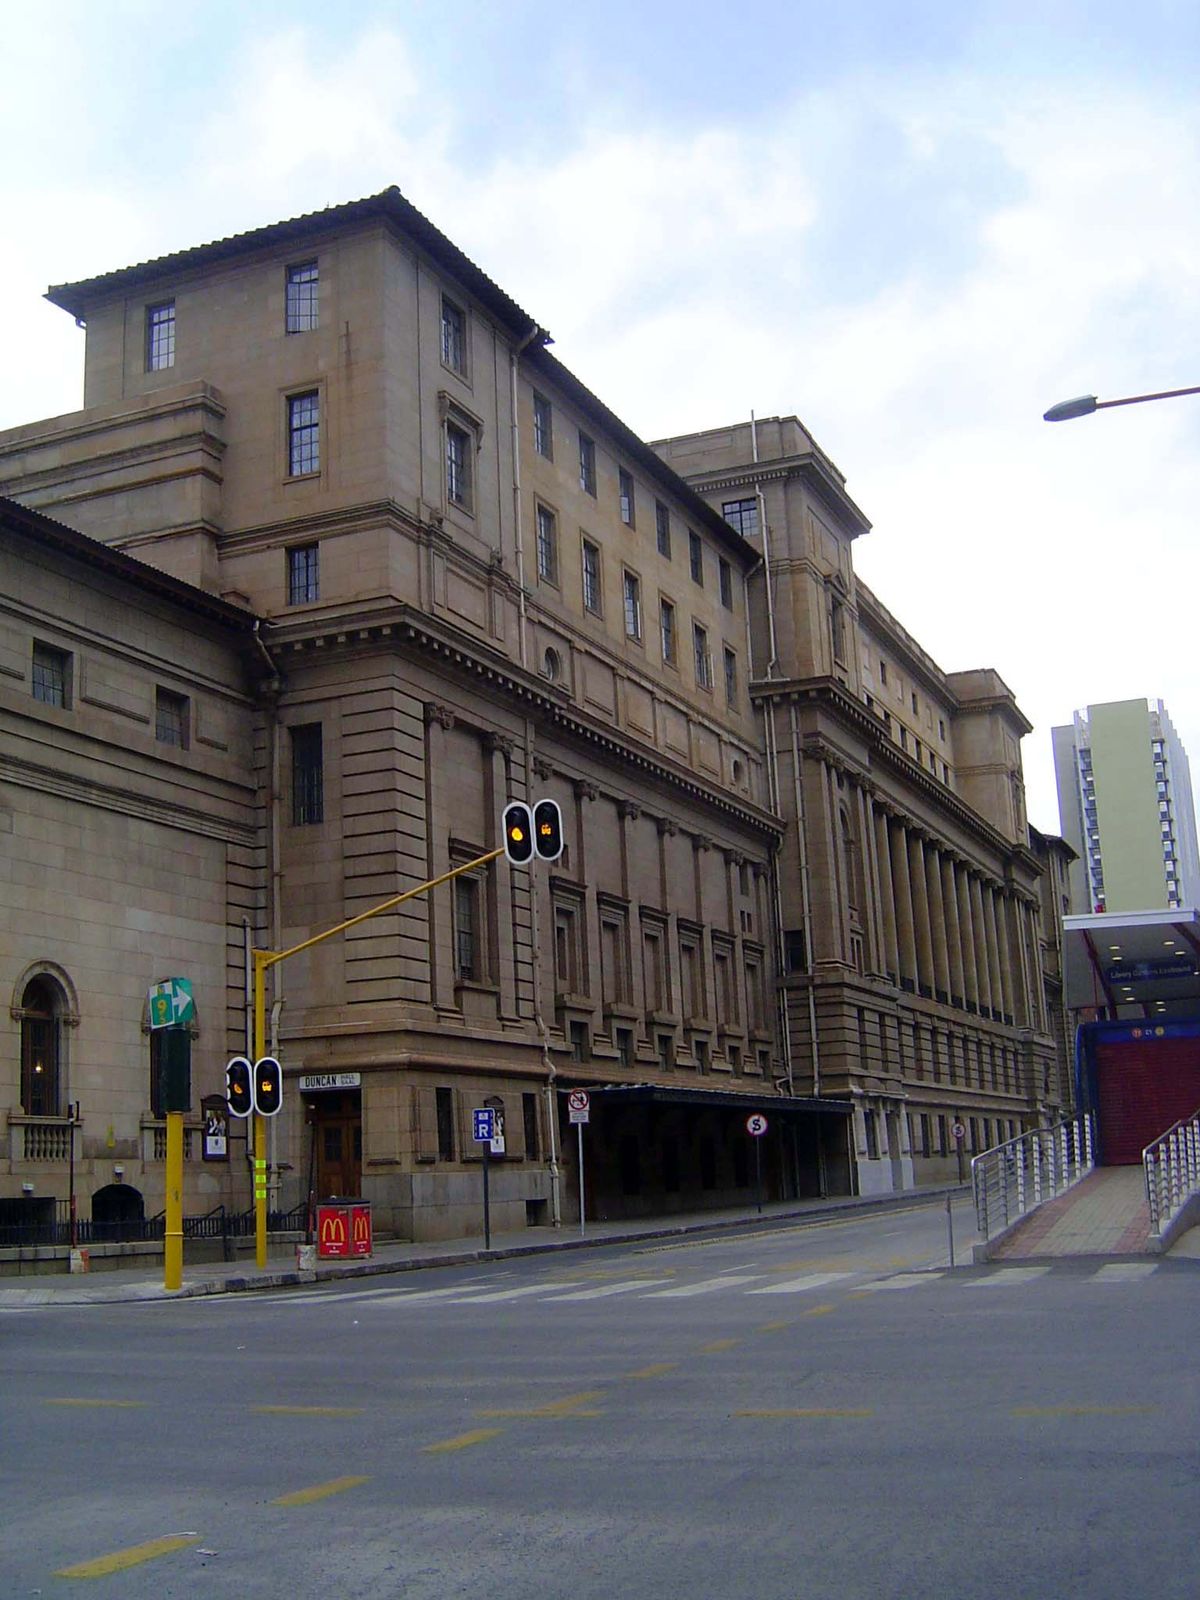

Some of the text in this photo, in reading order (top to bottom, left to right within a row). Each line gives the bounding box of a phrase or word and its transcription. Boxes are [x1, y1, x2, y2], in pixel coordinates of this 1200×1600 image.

[305, 1075, 337, 1087] DUNCAN
[478, 1123, 489, 1137] R
[322, 1218, 345, 1242] M
[354, 1216, 369, 1241] M
